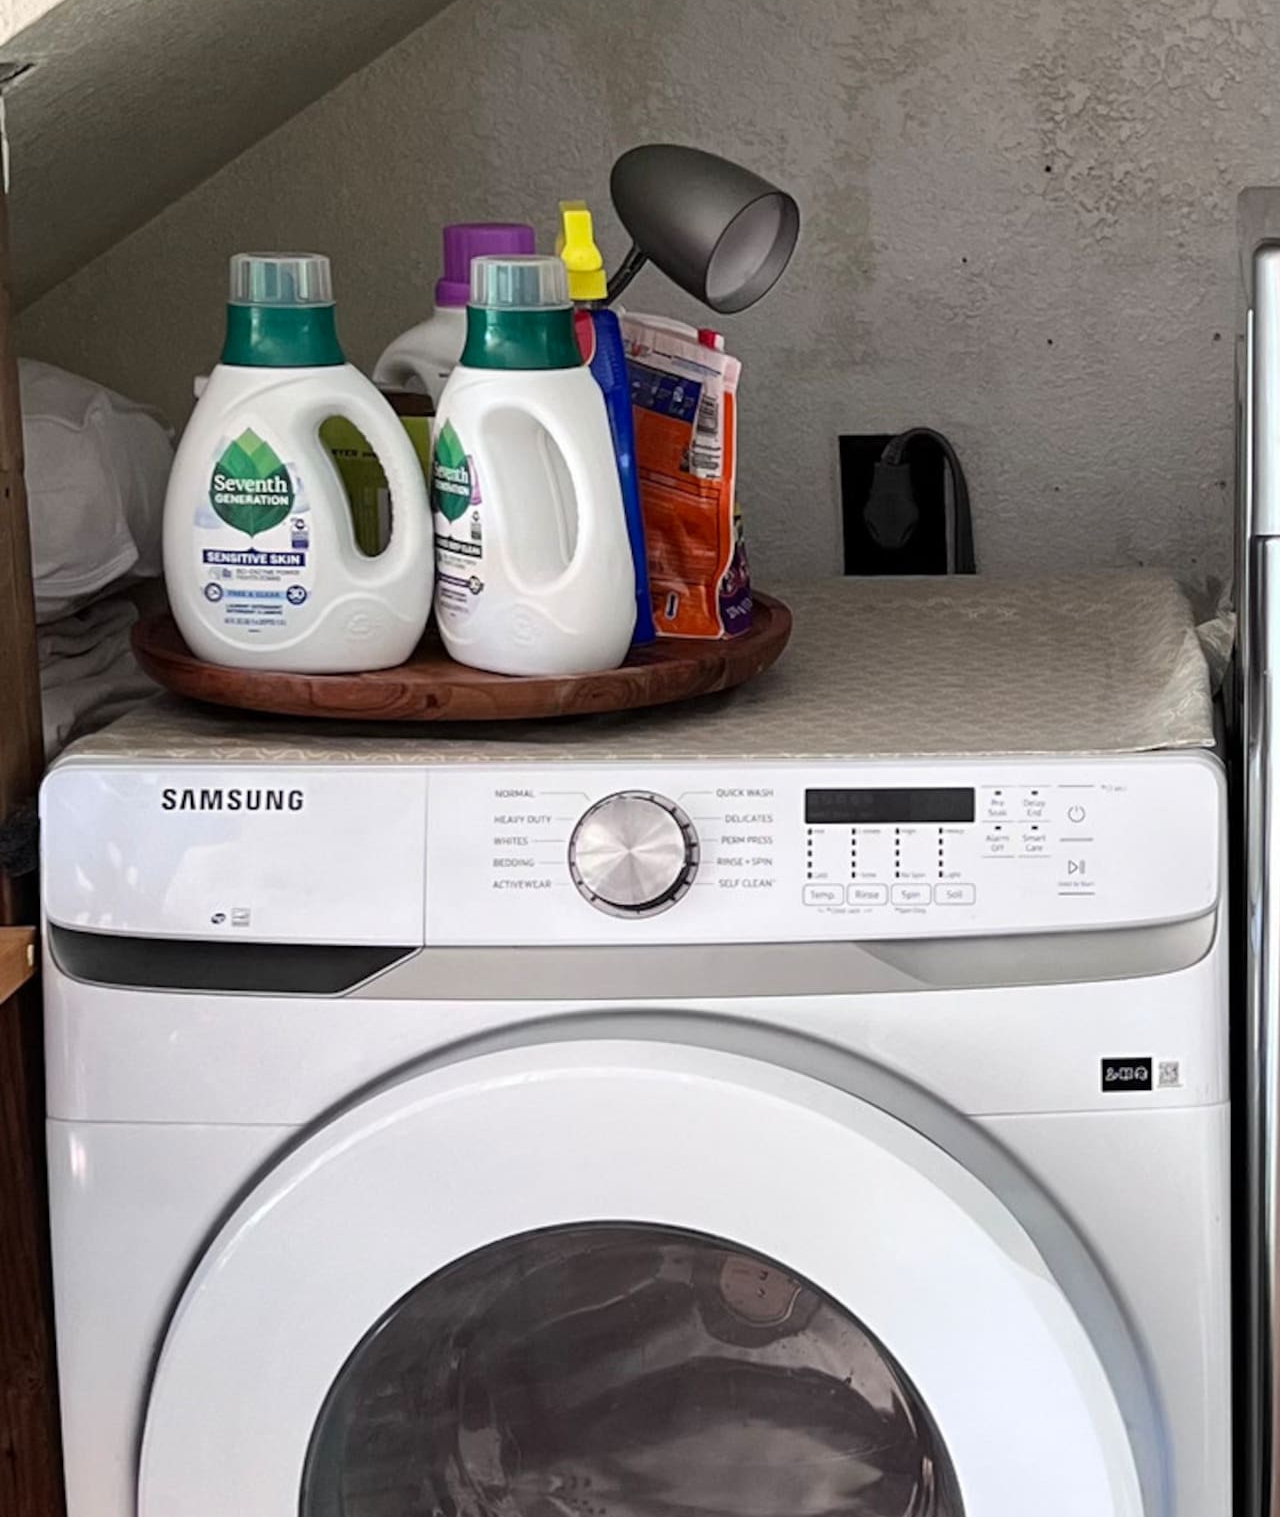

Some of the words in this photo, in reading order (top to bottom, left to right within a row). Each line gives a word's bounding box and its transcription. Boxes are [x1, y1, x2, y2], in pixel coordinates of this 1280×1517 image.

[213, 474, 288, 494] Seventh
[214, 493, 289, 506] GENERATION
[206, 551, 268, 565] SENSITIVE
[270, 551, 301, 565] SKIN
[494, 789, 536, 798] NORMAL
[716, 789, 745, 797] QUICK
[746, 789, 774, 797] WASH
[162, 788, 305, 811] SAMSUNG
[493, 815, 525, 824] HEAVY
[527, 815, 552, 824] DUTY
[724, 814, 774, 823] DELICATES
[493, 836, 529, 846] WHITES
[721, 835, 745, 844] PERM
[746, 835, 774, 844] PRESS
[1022, 834, 1046, 842] Smart
[492, 858, 535, 867] BEDDING
[716, 857, 743, 866] RINSE
[751, 857, 773, 866] SPIN
[492, 879, 552, 889] ACTIVEWEAR
[718, 878, 740, 888] SELF
[810, 889, 835, 900] Temp
[854, 889, 880, 899] Rinse
[900, 890, 921, 900] Spin
[945, 889, 964, 899] Soil
